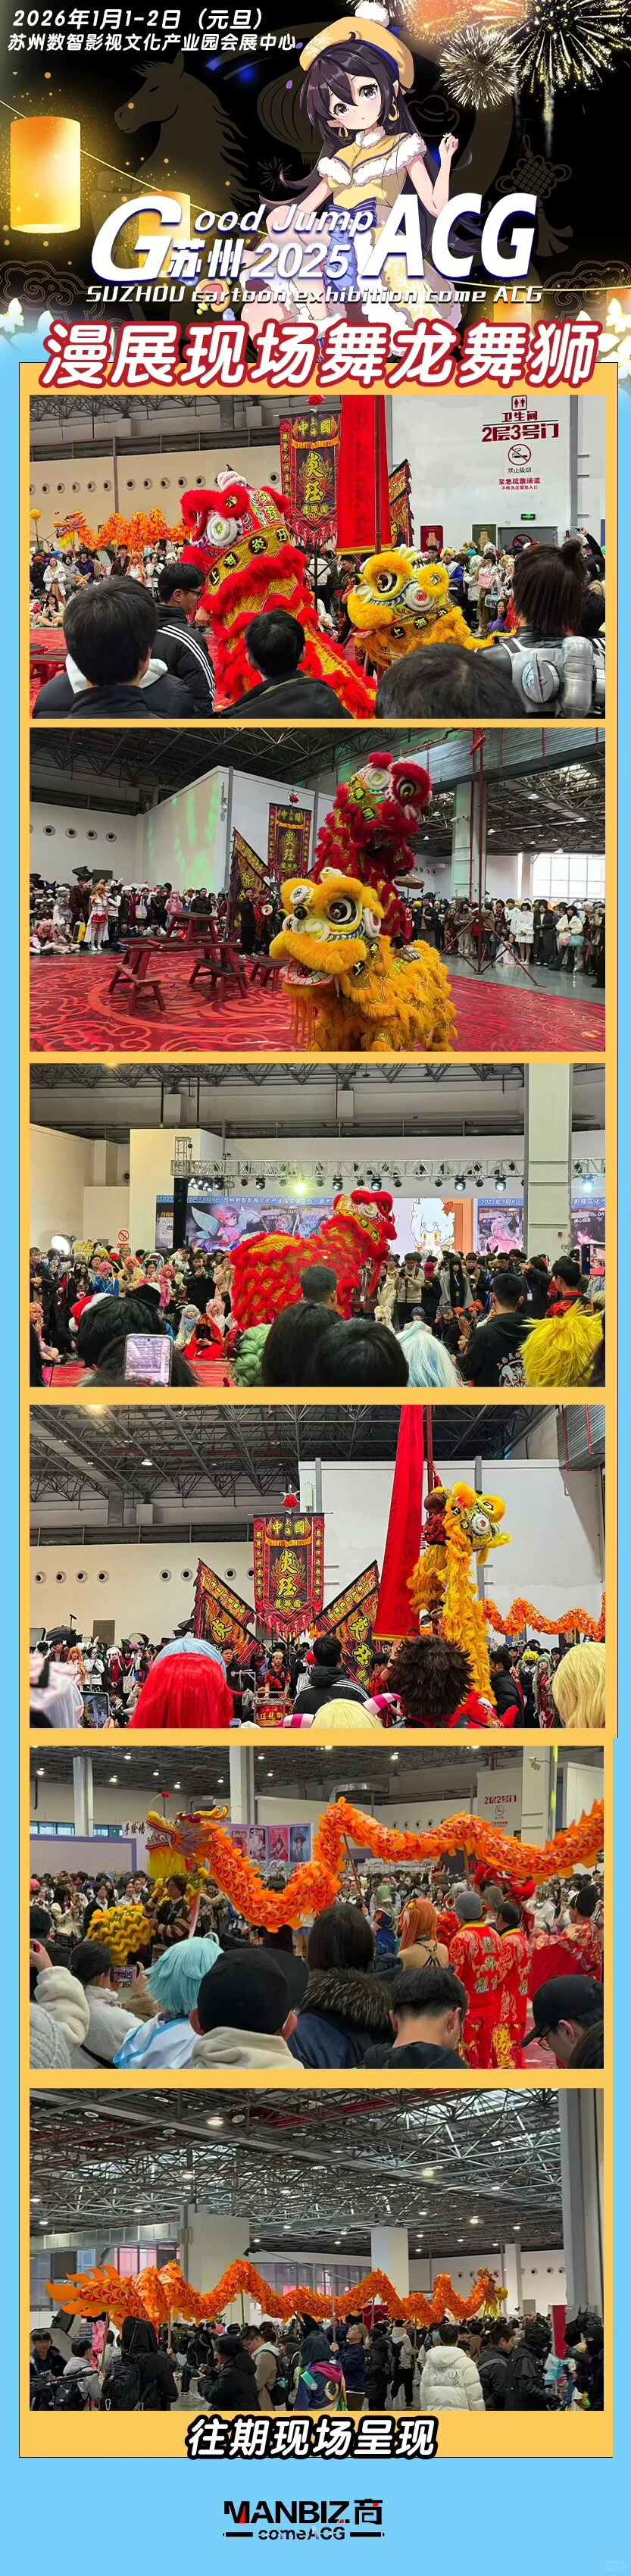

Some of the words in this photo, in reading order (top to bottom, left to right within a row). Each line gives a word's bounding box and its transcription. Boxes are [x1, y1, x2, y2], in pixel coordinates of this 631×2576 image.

[501, 411, 539, 423] 卫生间
[481, 423, 560, 442] 2层3号门
